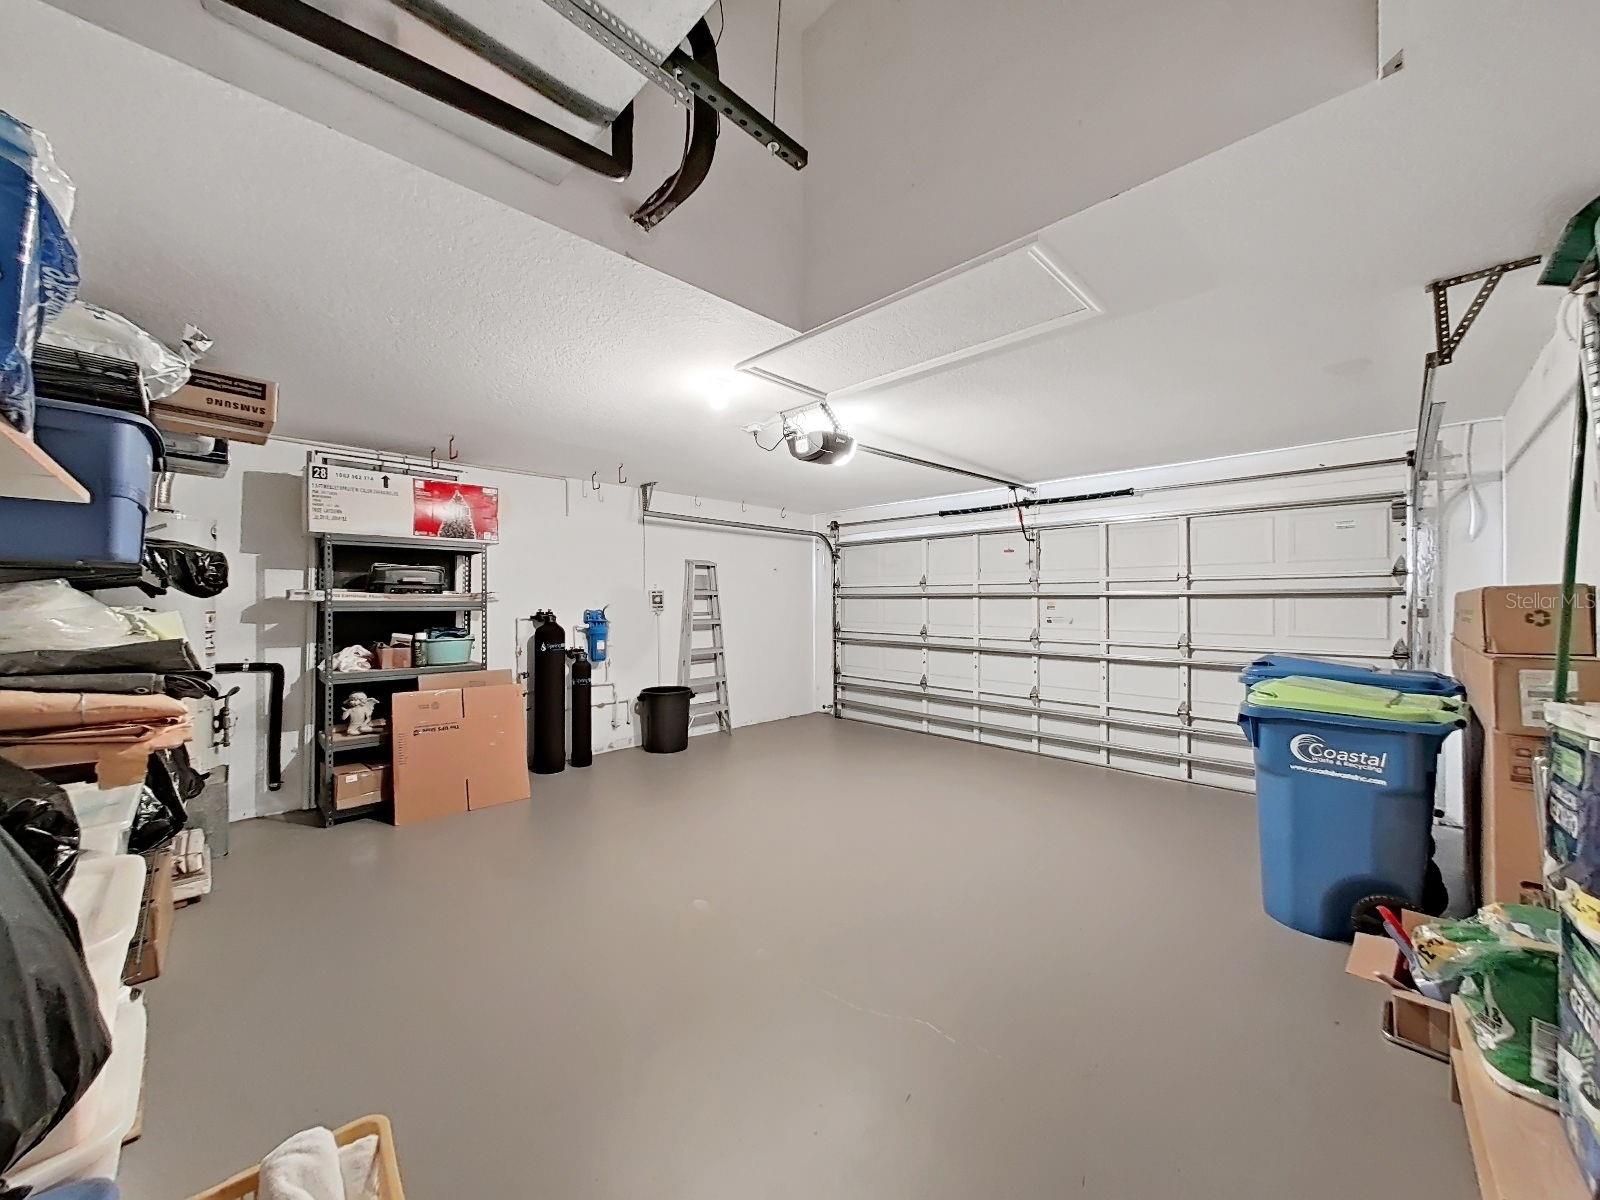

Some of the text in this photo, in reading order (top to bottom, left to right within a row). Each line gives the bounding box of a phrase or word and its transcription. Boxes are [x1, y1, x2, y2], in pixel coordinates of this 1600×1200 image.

[205, 397, 266, 415] SAMSUNG
[313, 467, 327, 479] 28
[1308, 743, 1387, 768] Coastal
[1312, 756, 1334, 765] Waste
[1343, 761, 1383, 774] Recycling
